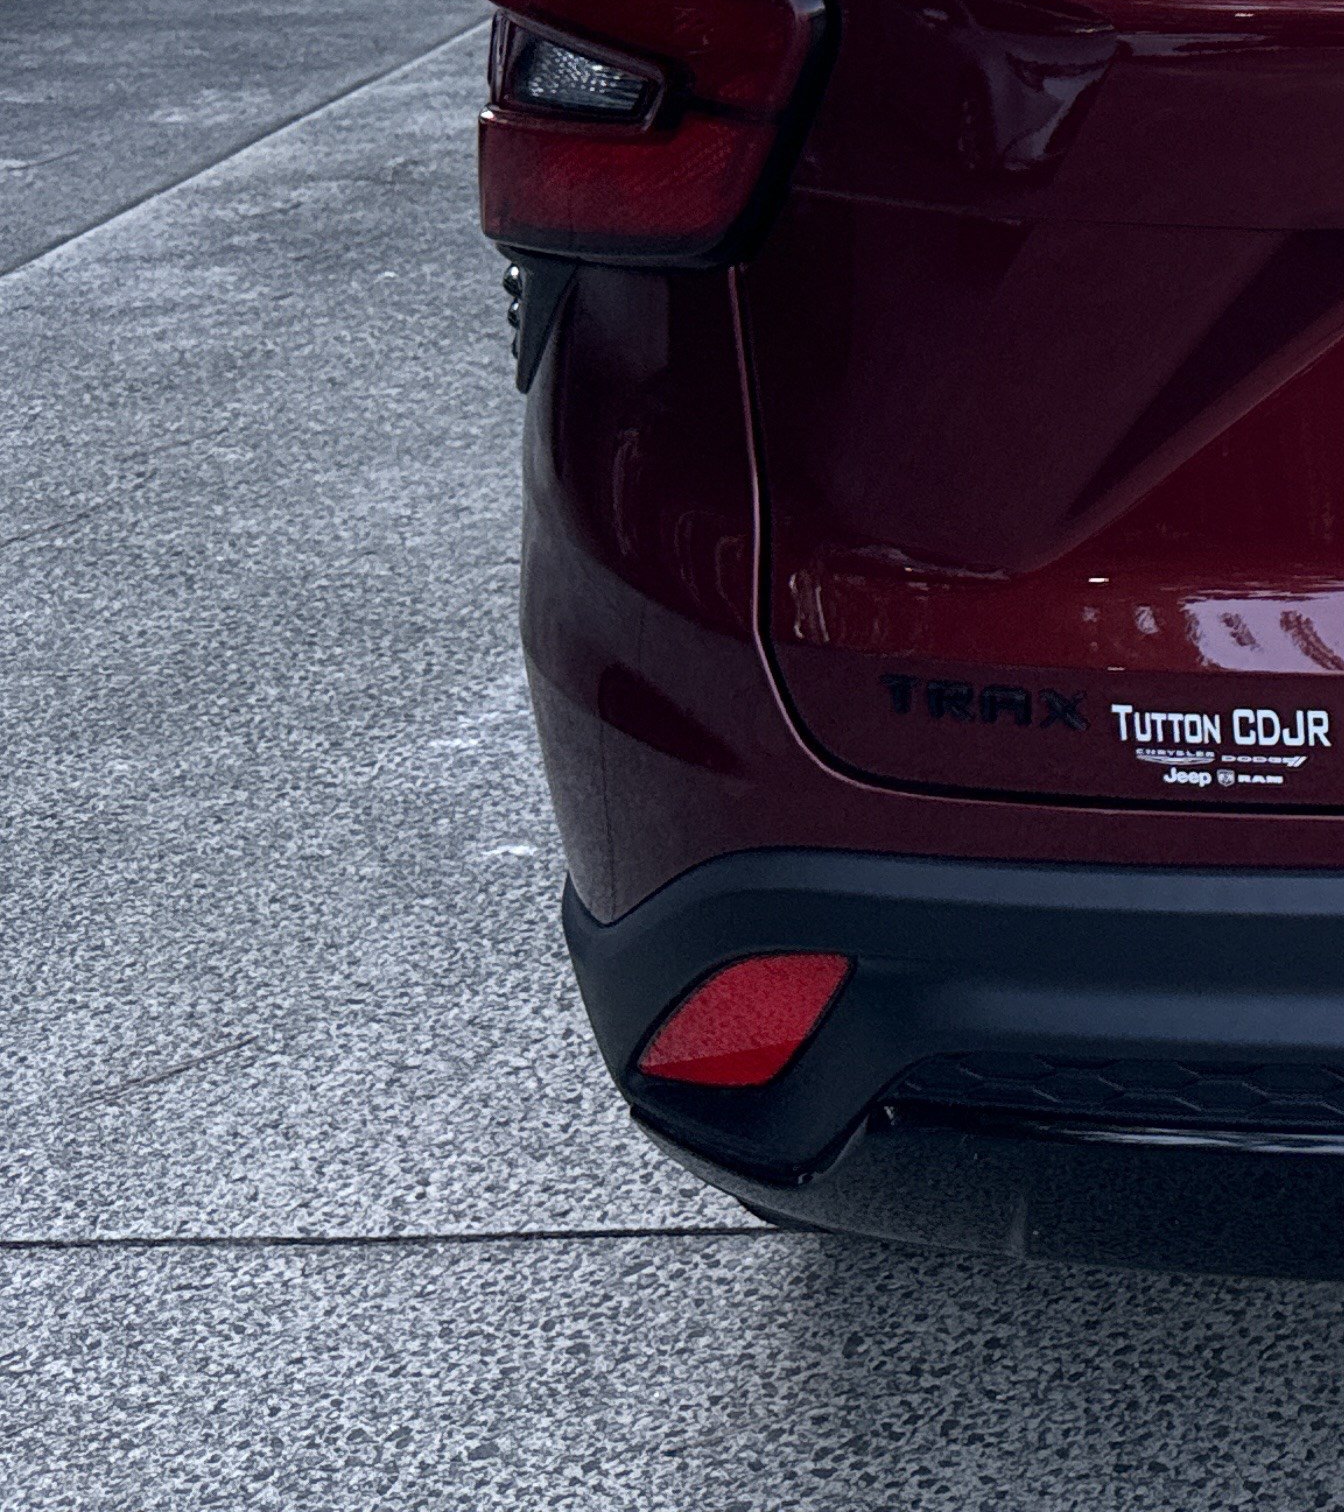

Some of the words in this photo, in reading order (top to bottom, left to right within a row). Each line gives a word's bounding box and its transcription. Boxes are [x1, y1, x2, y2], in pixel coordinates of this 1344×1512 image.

[879, 672, 1091, 731] TRAX
[1111, 703, 1221, 745] TUTTON
[1231, 707, 1332, 747] CDJR
[1135, 747, 1215, 758] CHRYSLER
[1163, 766, 1213, 788] Jeep
[1237, 774, 1284, 785] RAM
